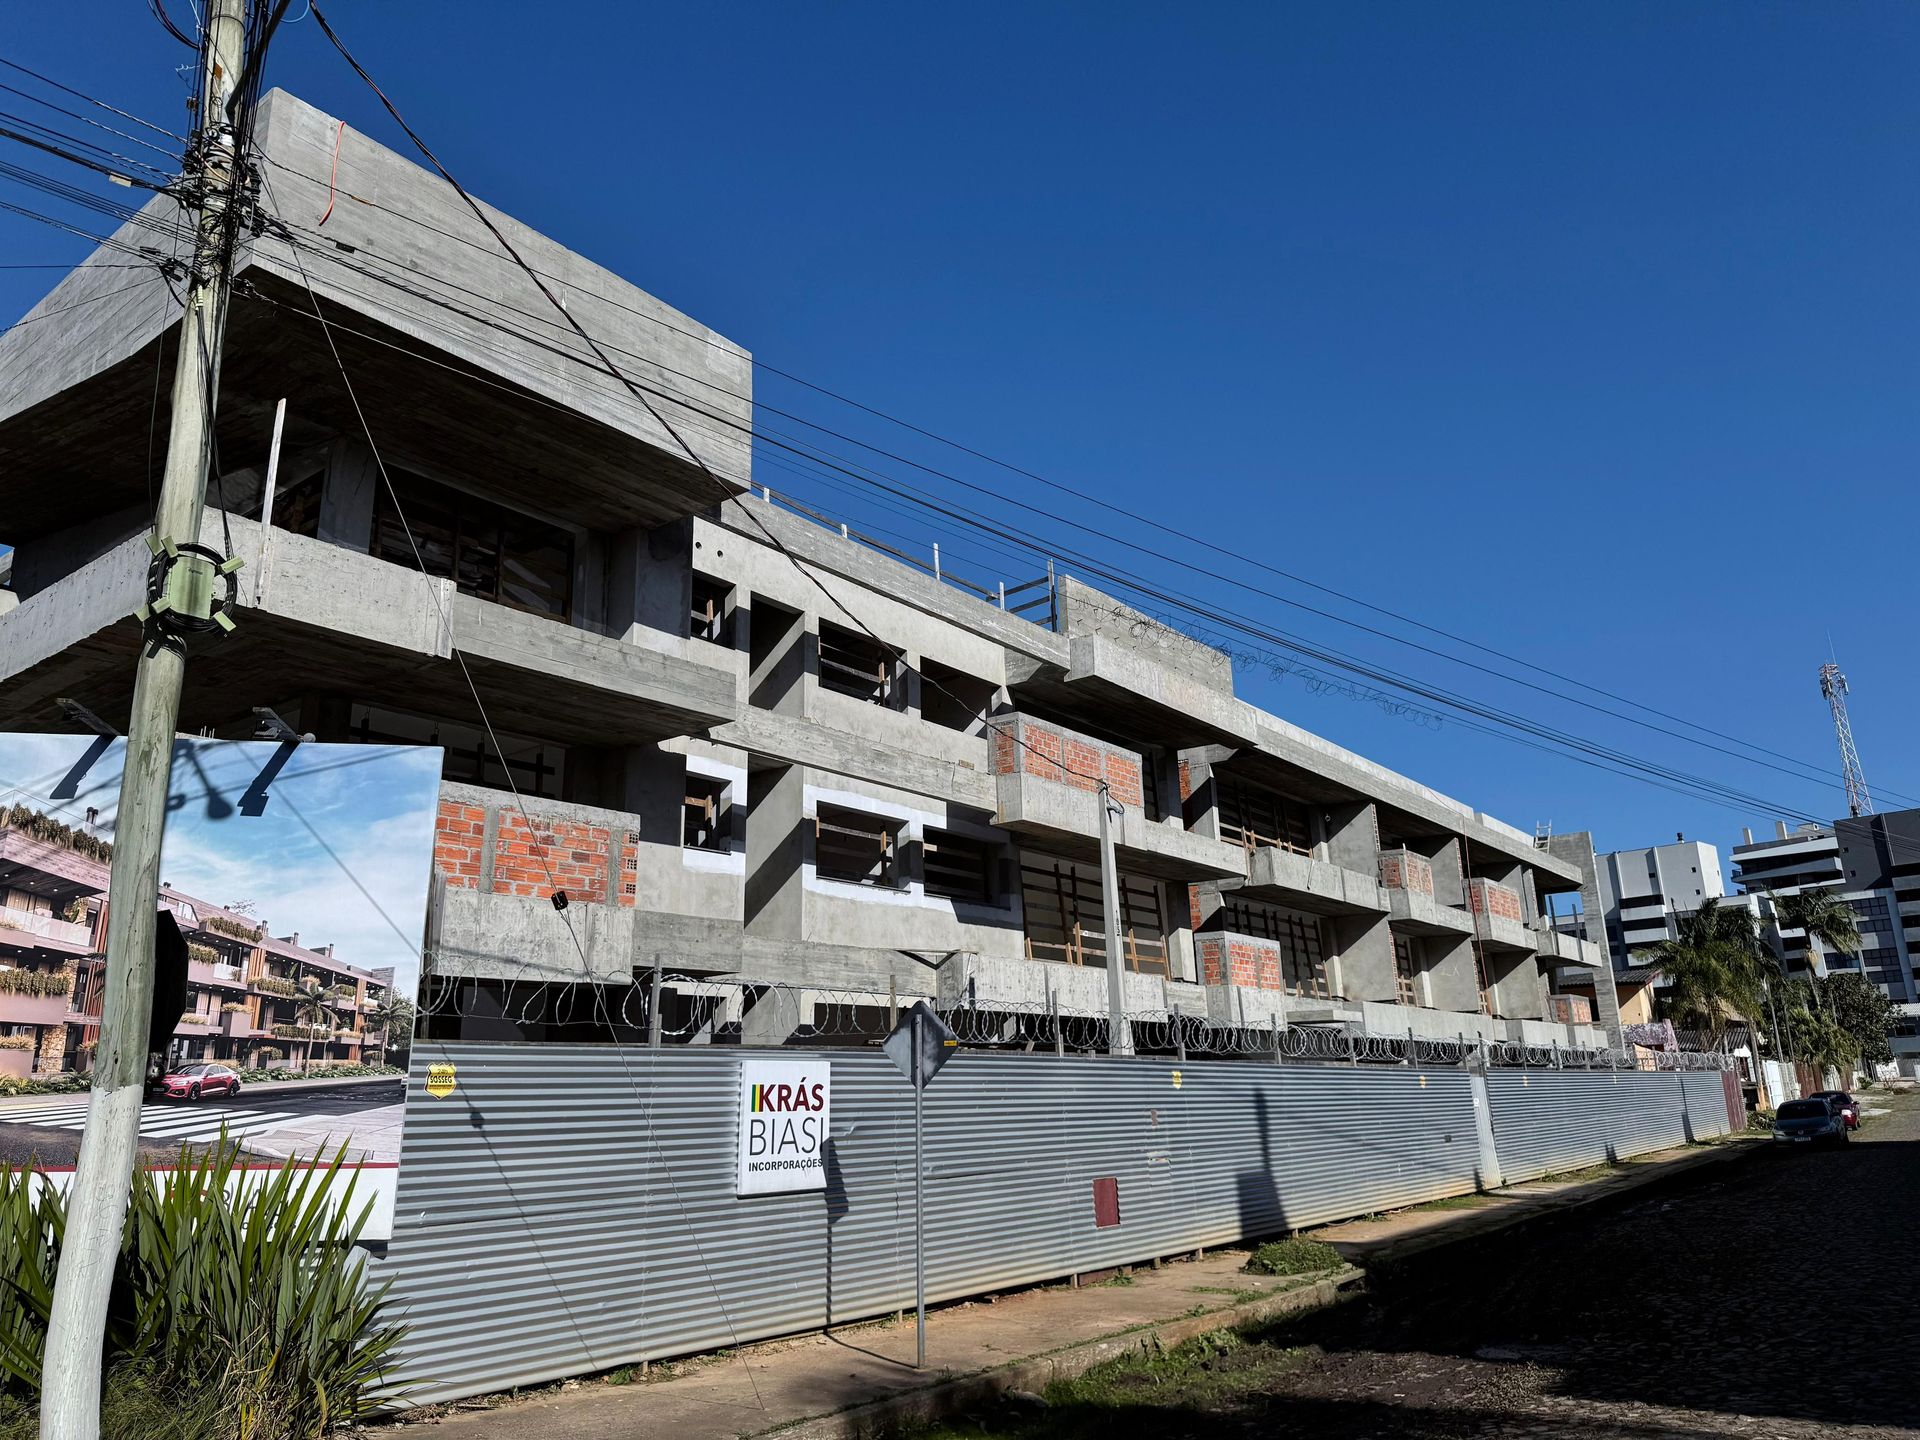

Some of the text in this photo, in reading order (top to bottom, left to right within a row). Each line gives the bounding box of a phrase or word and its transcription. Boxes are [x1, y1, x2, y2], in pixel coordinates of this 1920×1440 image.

[430, 1075, 452, 1083] SOSSEG
[758, 1076, 825, 1112] KRÁS
[749, 1116, 824, 1156] BIASI
[748, 1157, 823, 1172] INCORPORAÇÕES
